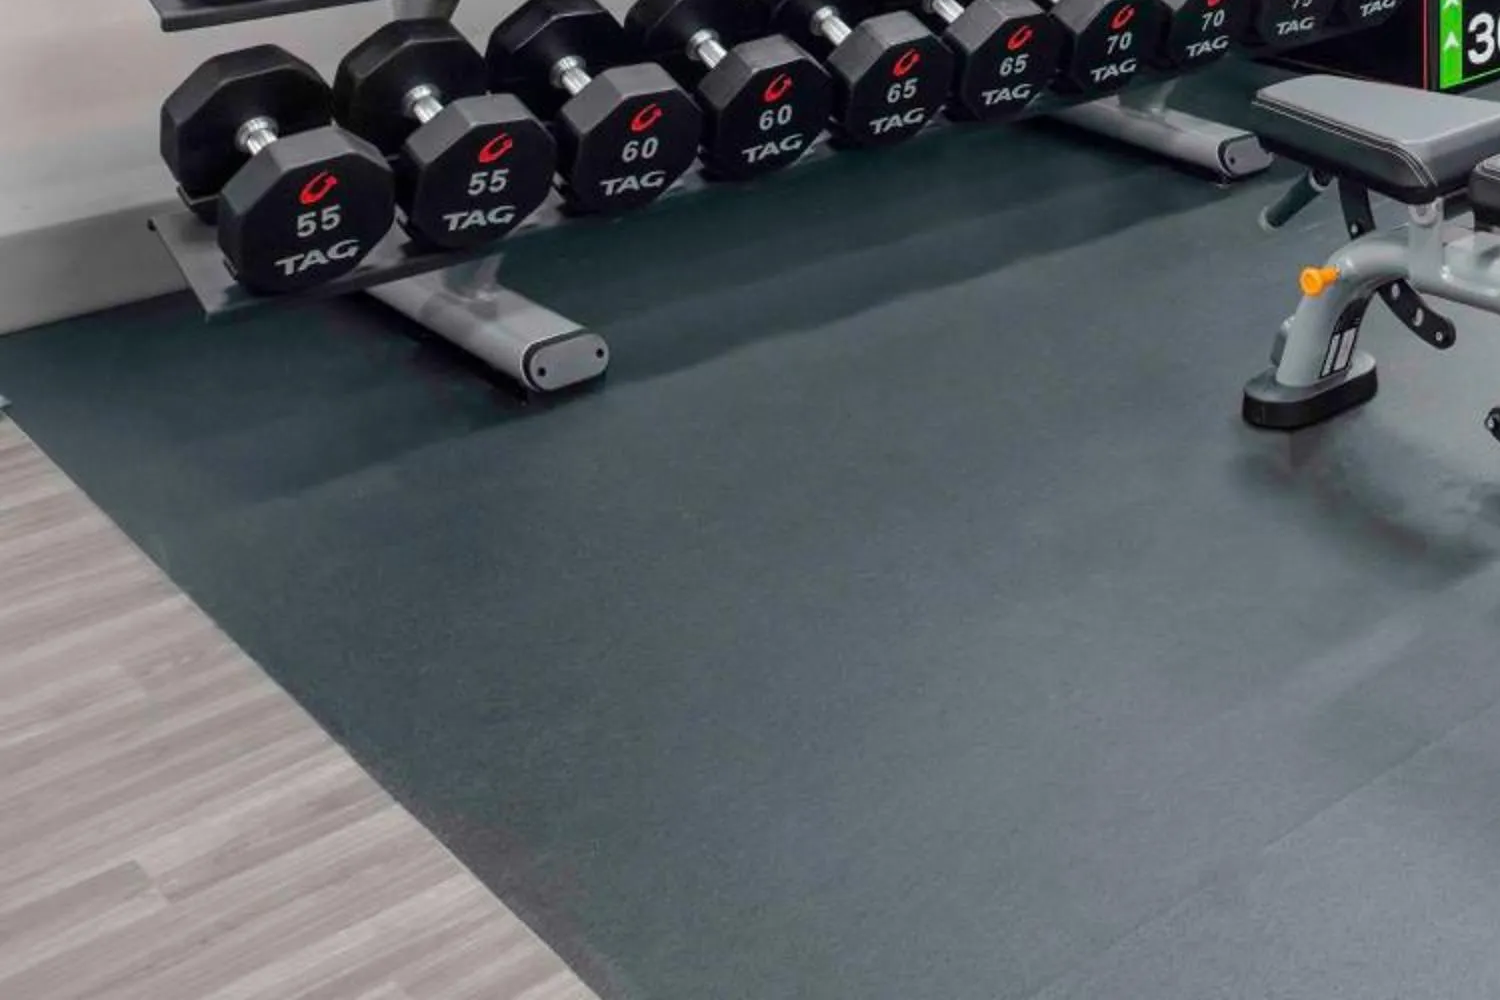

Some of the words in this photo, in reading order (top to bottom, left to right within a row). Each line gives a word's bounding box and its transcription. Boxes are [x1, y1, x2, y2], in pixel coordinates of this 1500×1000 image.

[1202, 9, 1224, 31] 70
[1277, 16, 1314, 34] TAG
[1108, 32, 1132, 54] 70
[1187, 36, 1228, 56] TAG
[1000, 54, 1029, 76] 65
[1091, 59, 1136, 82] TAG
[887, 79, 917, 103] 65
[982, 84, 1031, 105] TAG
[760, 105, 792, 130] 60
[870, 108, 926, 134] TAG
[622, 137, 658, 162] 60
[742, 135, 805, 164] TAG
[468, 169, 509, 195] 55
[600, 171, 665, 195] TAG
[298, 205, 340, 237] 55
[443, 206, 515, 231] TAG
[275, 240, 361, 275] TAG
